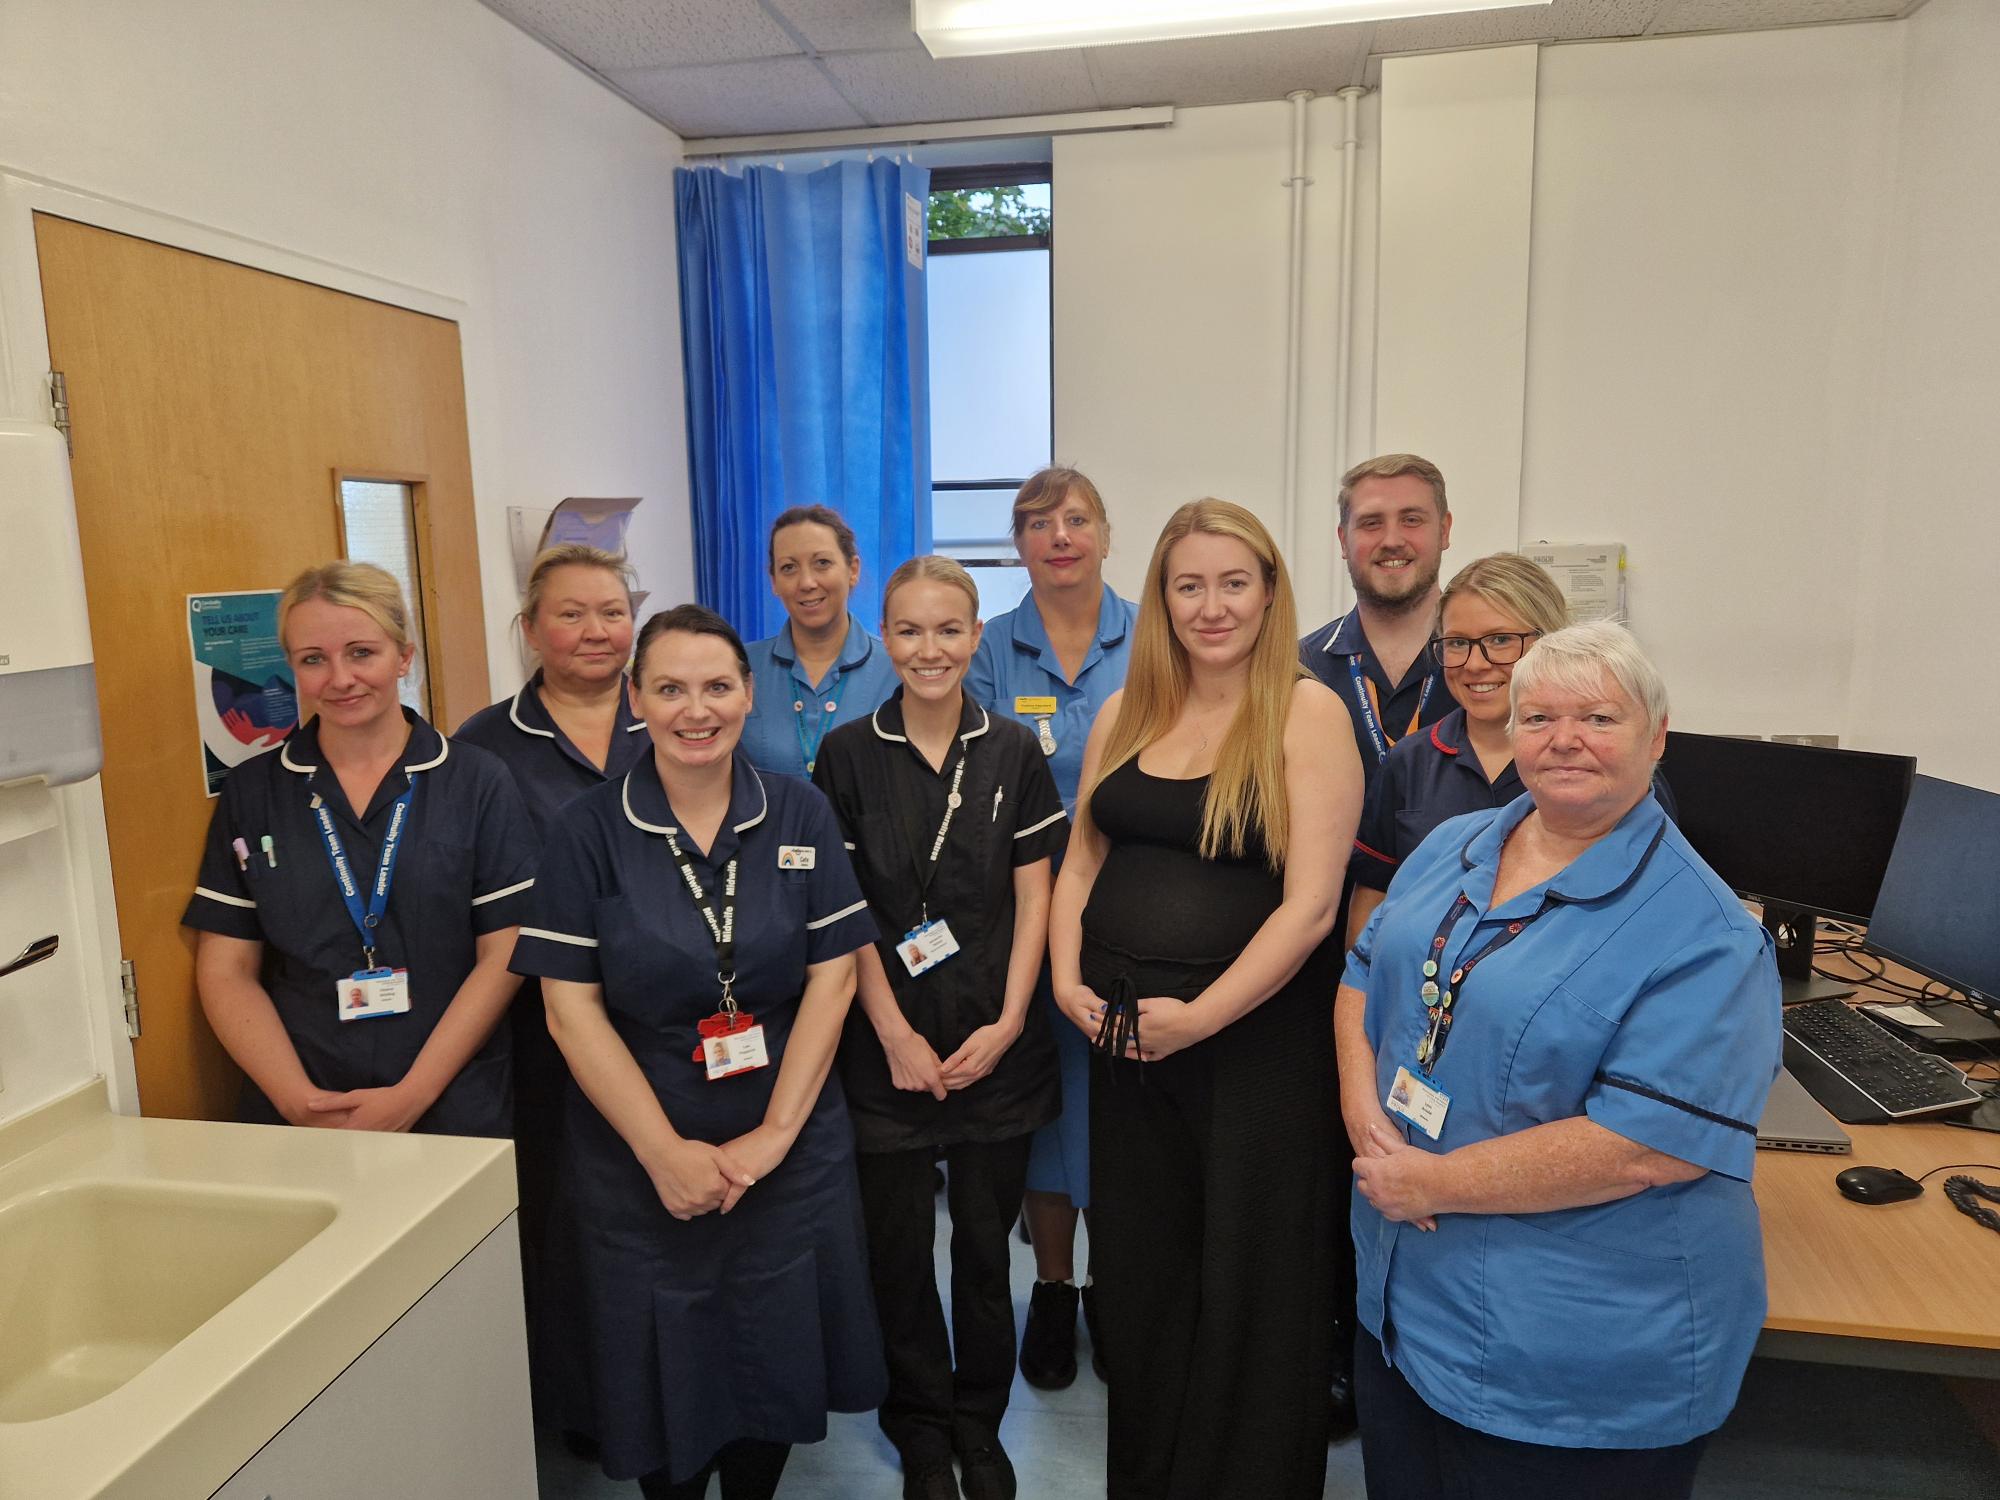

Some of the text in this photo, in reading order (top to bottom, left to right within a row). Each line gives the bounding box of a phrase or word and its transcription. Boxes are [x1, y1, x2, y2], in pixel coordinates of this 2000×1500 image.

[202, 615, 220, 625] TELL
[221, 614, 232, 624] US
[203, 625, 249, 637] YOUR CARE
[1355, 676, 1382, 752] Continuity Team Leader
[377, 802, 405, 896] Continuity Team Leader
[930, 804, 954, 861] aternity Matron
[318, 808, 355, 897] Continuity Team Leader
[680, 863, 703, 899] Midwife
[725, 860, 737, 896] Midwife
[722, 906, 734, 943] Midwife
